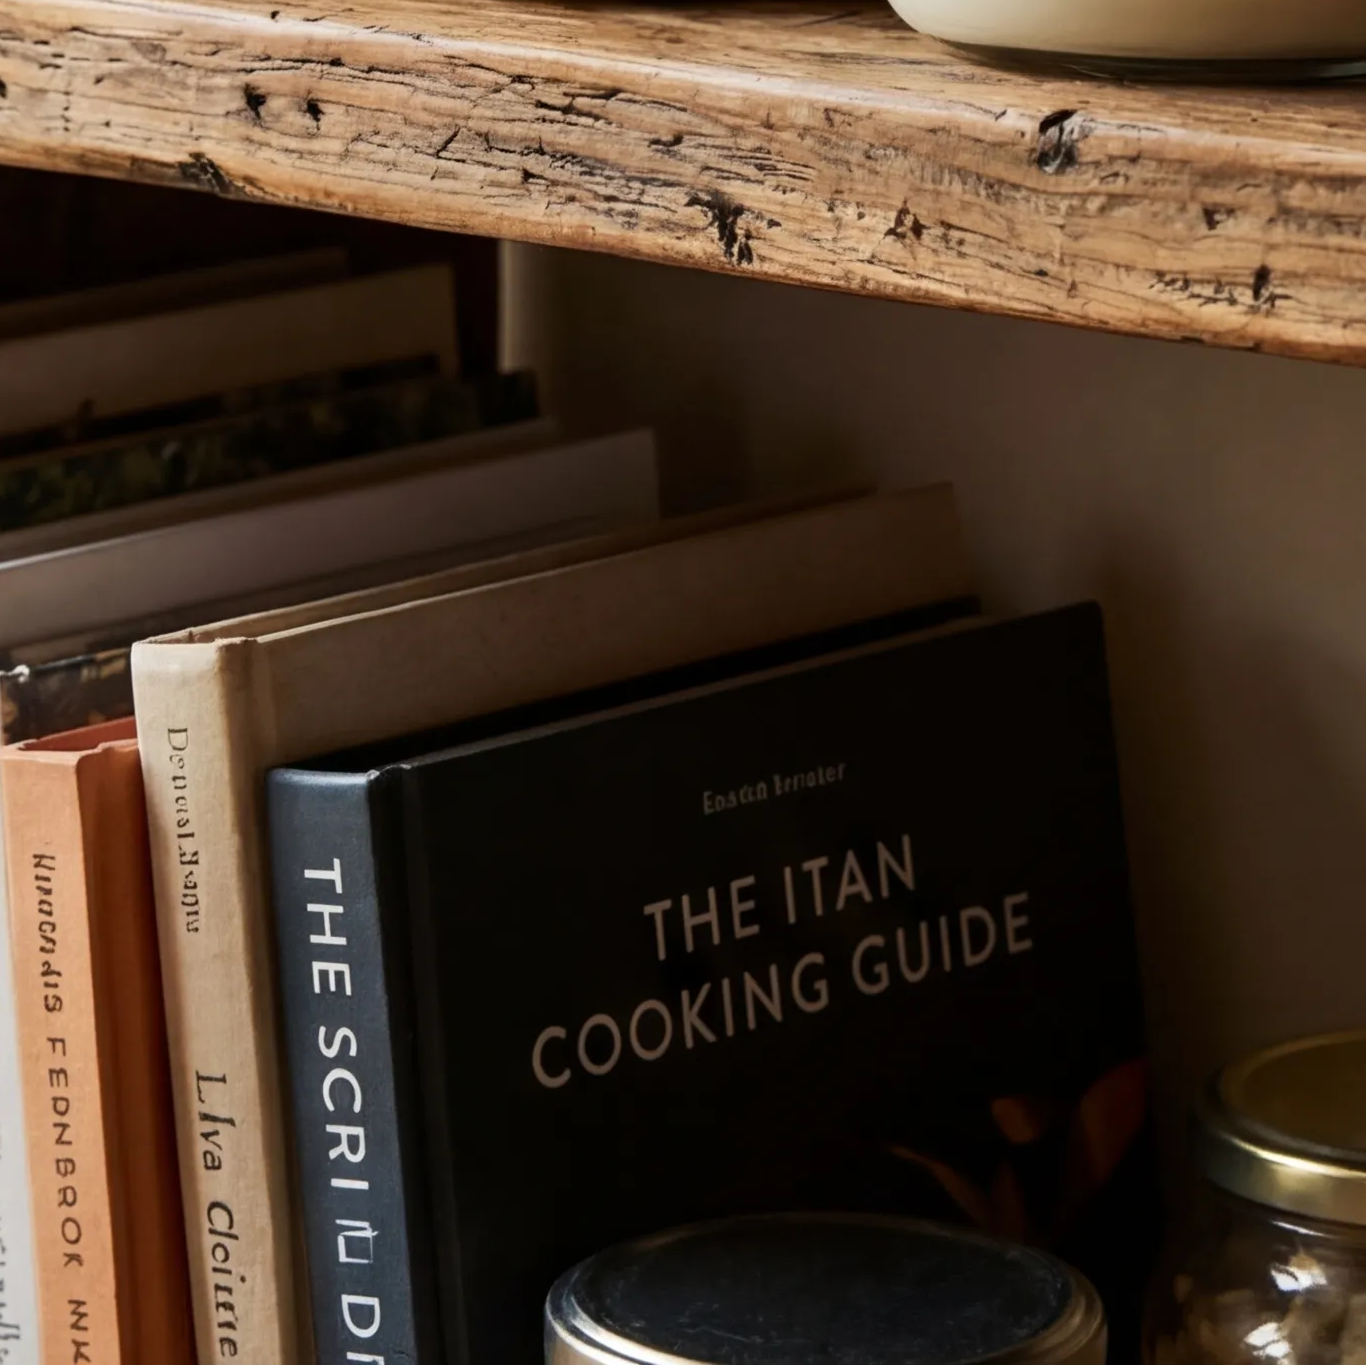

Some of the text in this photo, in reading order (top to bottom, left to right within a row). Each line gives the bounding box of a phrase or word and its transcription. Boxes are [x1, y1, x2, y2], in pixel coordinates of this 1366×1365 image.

[302, 857, 353, 997] THE
[643, 834, 916, 963] THE ITAN
[532, 892, 1033, 1089] COOKING GUIDE
